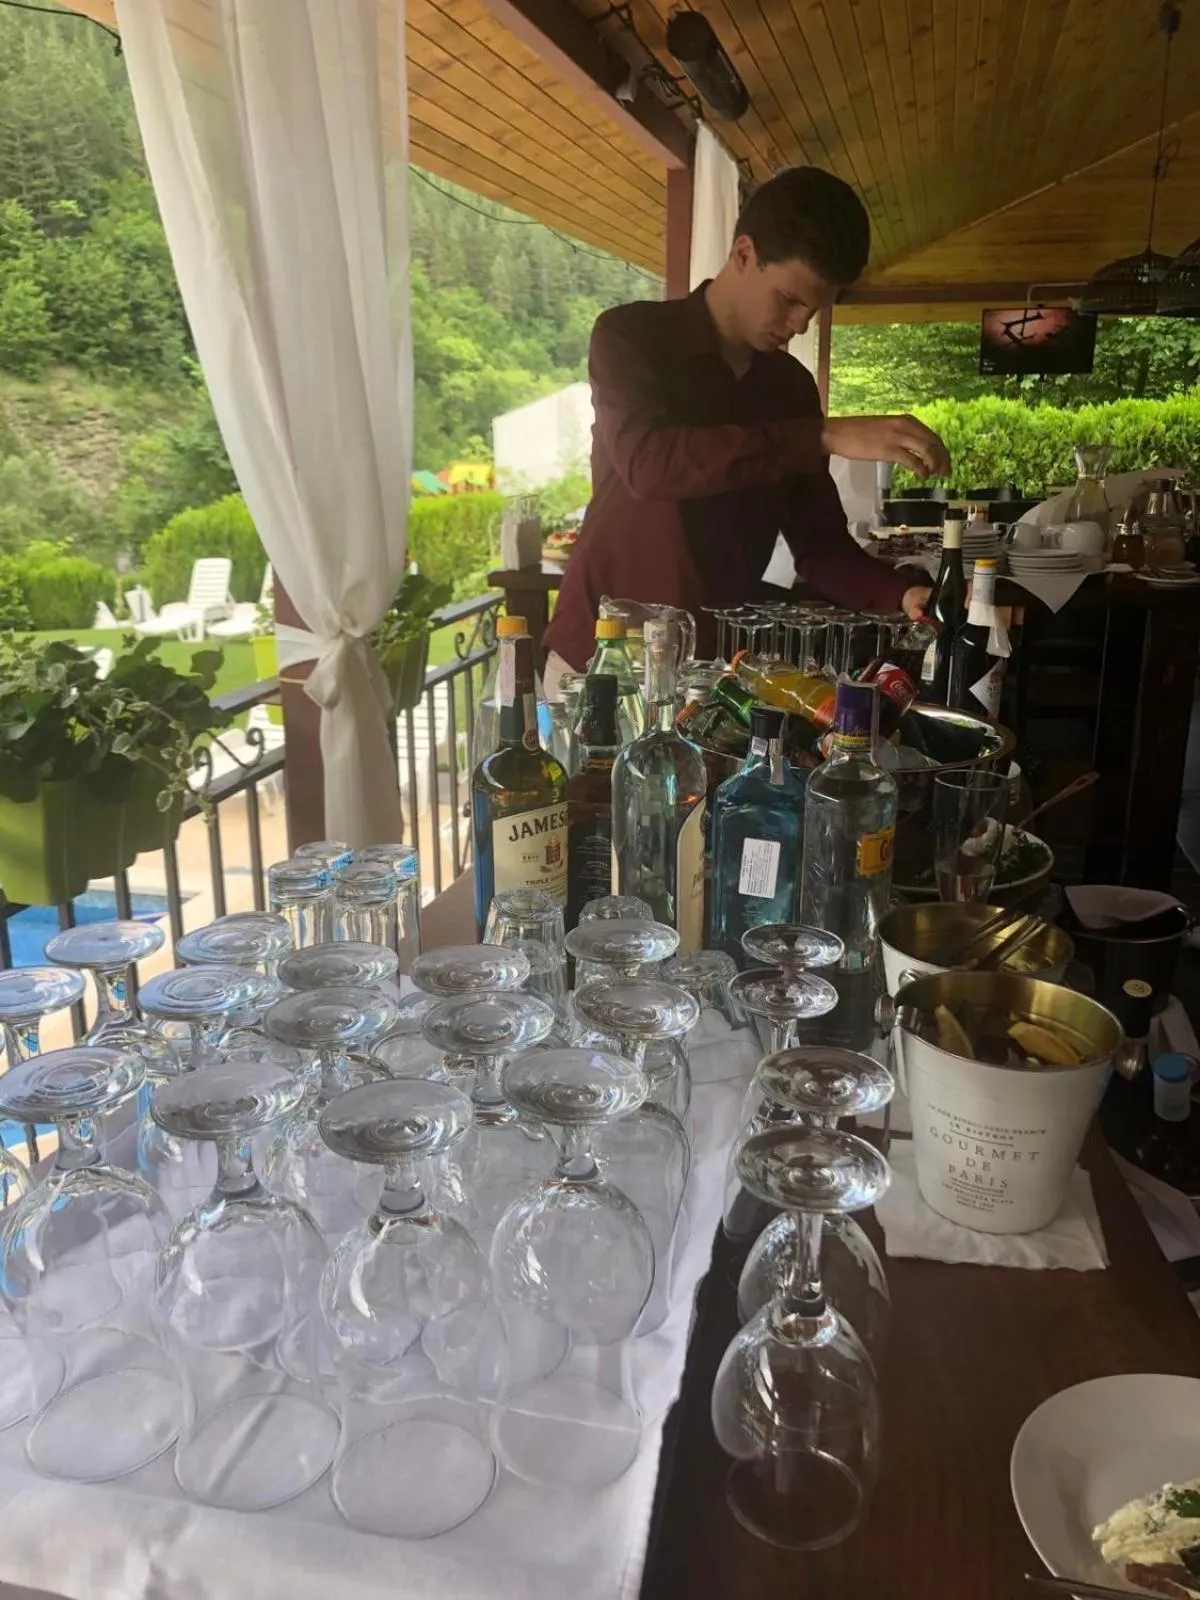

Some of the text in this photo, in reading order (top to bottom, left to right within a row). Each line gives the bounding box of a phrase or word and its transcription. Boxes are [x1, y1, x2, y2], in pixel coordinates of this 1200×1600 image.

[930, 1127, 1039, 1161] GOURMET
[948, 1163, 1008, 1188] PARIS
[965, 1156, 992, 1173] DE
